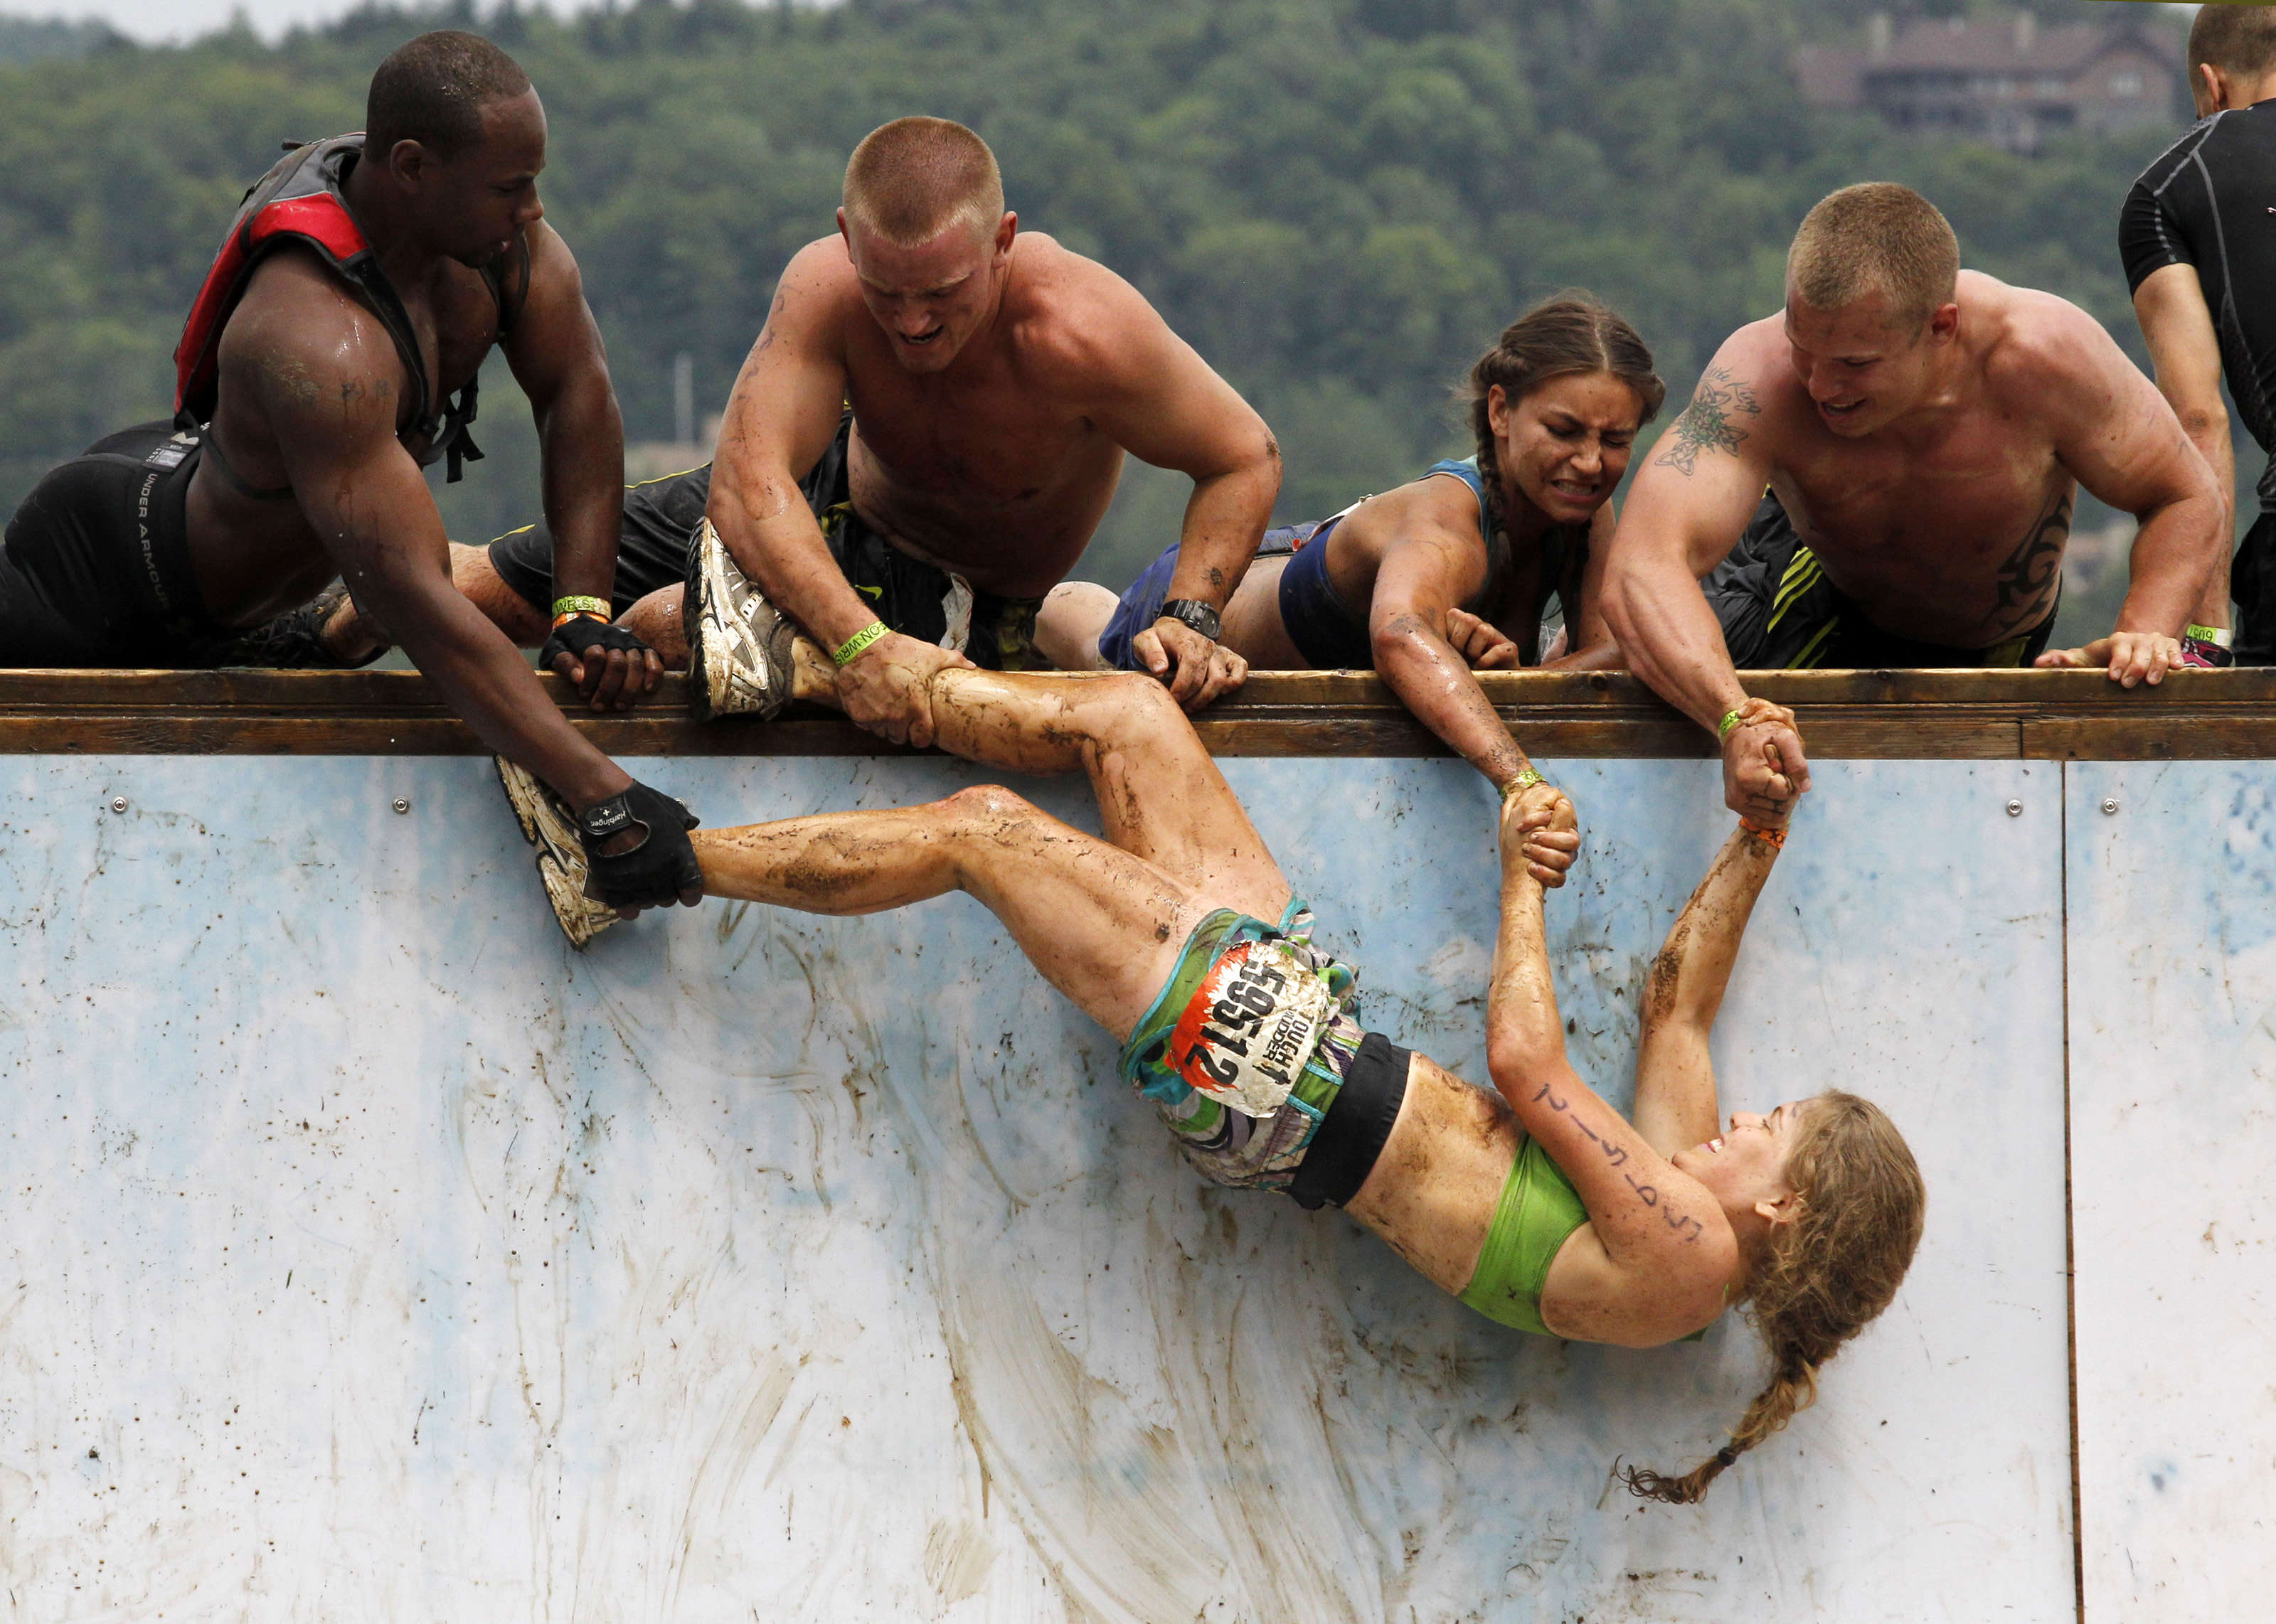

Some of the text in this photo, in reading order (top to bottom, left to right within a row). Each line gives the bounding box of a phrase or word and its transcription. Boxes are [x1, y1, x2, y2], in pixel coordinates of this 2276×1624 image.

[138, 472, 158, 518] UNDER
[1184, 958, 1287, 1086] 59512
[1275, 1010, 1315, 1069] TOUGH
